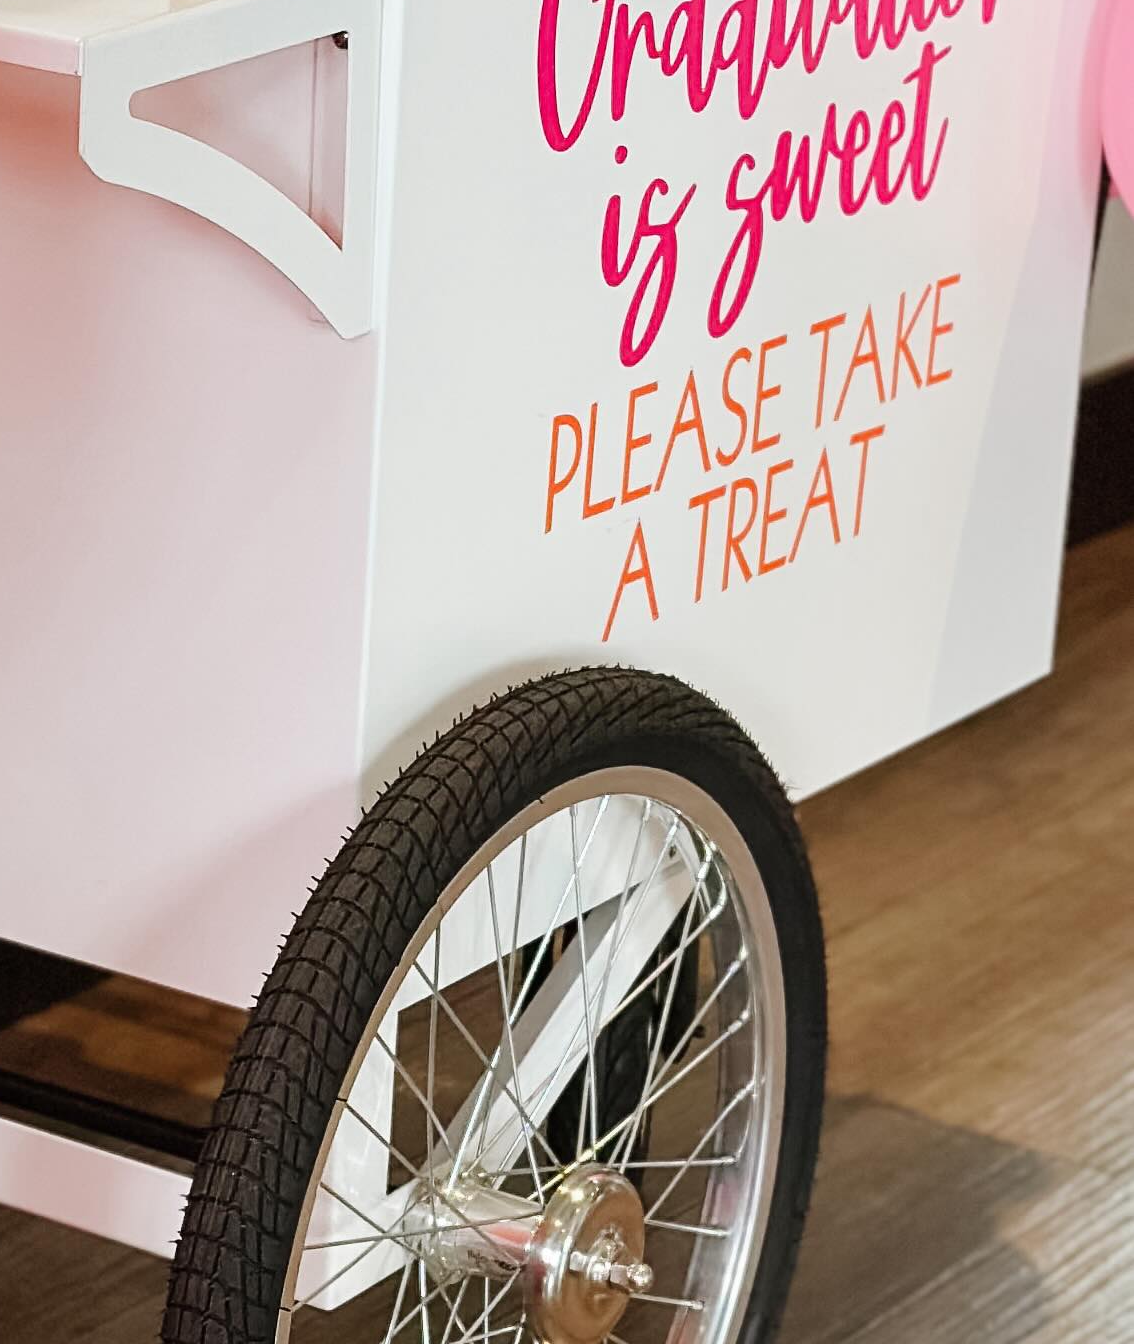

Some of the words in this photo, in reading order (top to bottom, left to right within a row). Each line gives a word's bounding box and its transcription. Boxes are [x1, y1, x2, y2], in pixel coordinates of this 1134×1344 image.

[601, 145, 697, 368] is
[707, 41, 951, 339] sweet
[545, 335, 788, 534] PLEASE
[810, 274, 961, 428] TAKE
[602, 518, 659, 642] A
[689, 425, 885, 602] TREAT
